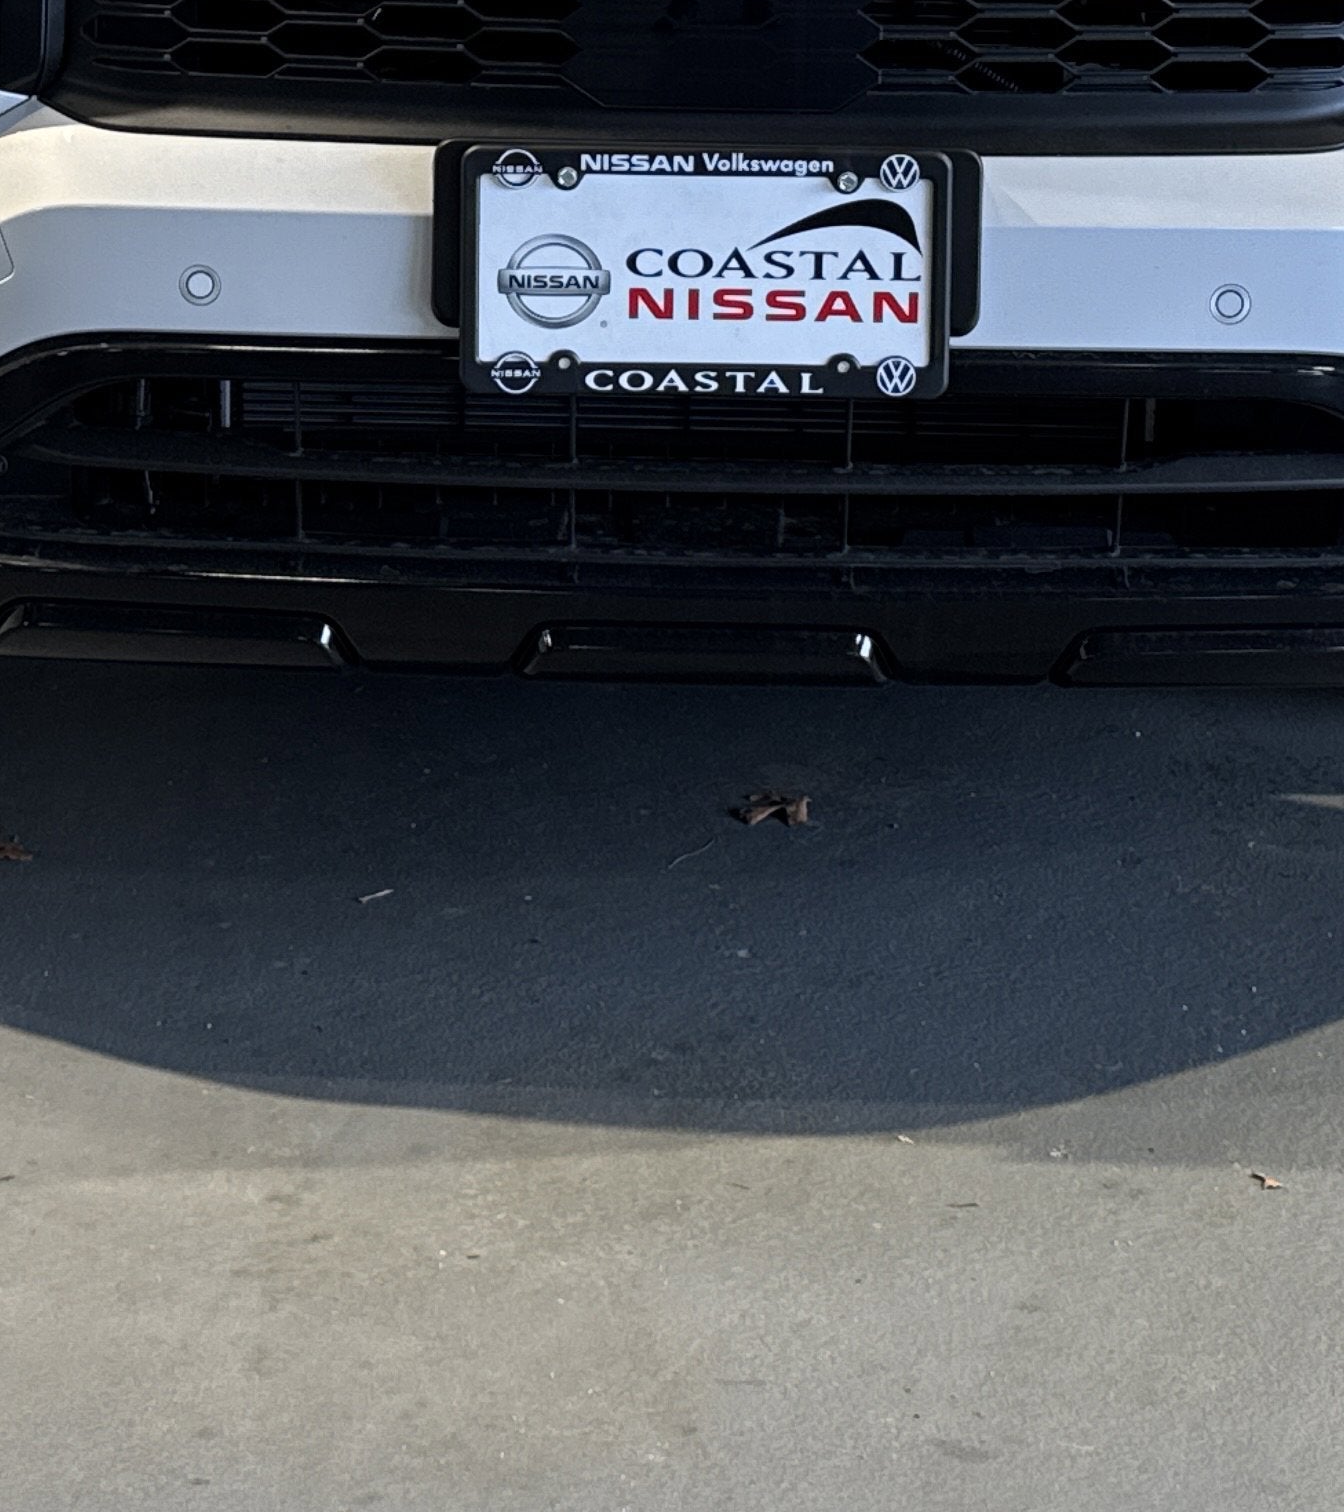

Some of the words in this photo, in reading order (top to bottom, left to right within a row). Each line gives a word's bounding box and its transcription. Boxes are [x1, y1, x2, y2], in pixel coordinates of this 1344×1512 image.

[492, 164, 543, 174] NISSAN
[580, 154, 694, 172] NISSAN
[702, 153, 834, 176] Volkswagen
[625, 247, 922, 281] COASTAL
[508, 273, 600, 290] NISSAN
[628, 287, 919, 323] NISSAN
[491, 368, 541, 378] NISSAN
[584, 368, 824, 395] COASTAL
